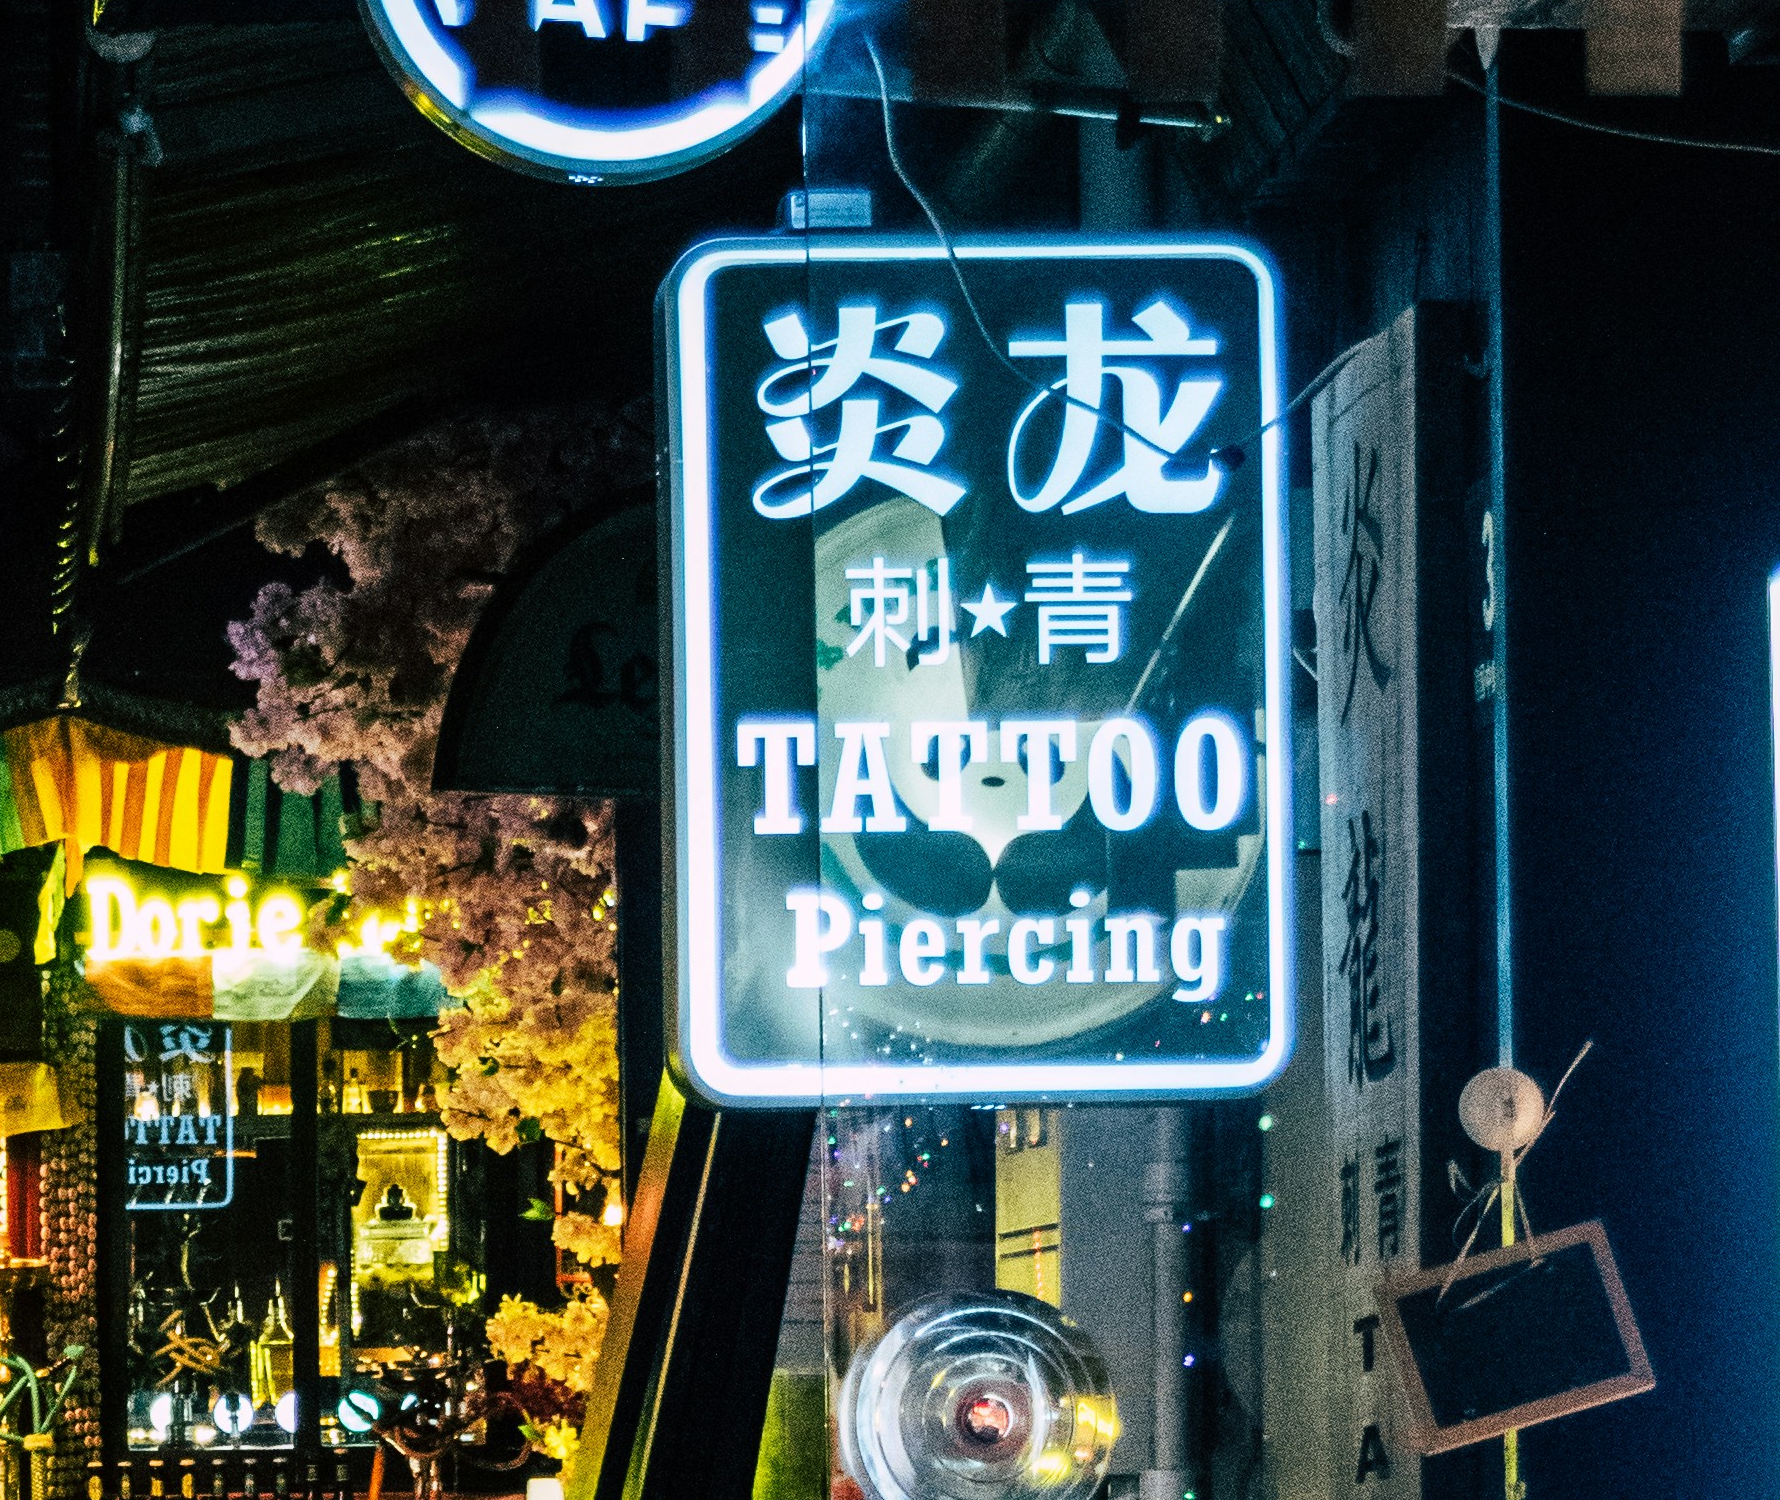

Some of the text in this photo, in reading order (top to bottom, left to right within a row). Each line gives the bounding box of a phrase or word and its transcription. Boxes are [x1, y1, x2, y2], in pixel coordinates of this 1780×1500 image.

[752, 299, 1225, 519] 炎龙
[736, 715, 1251, 836] TATTOO
[783, 886, 1228, 1002] Piercing
